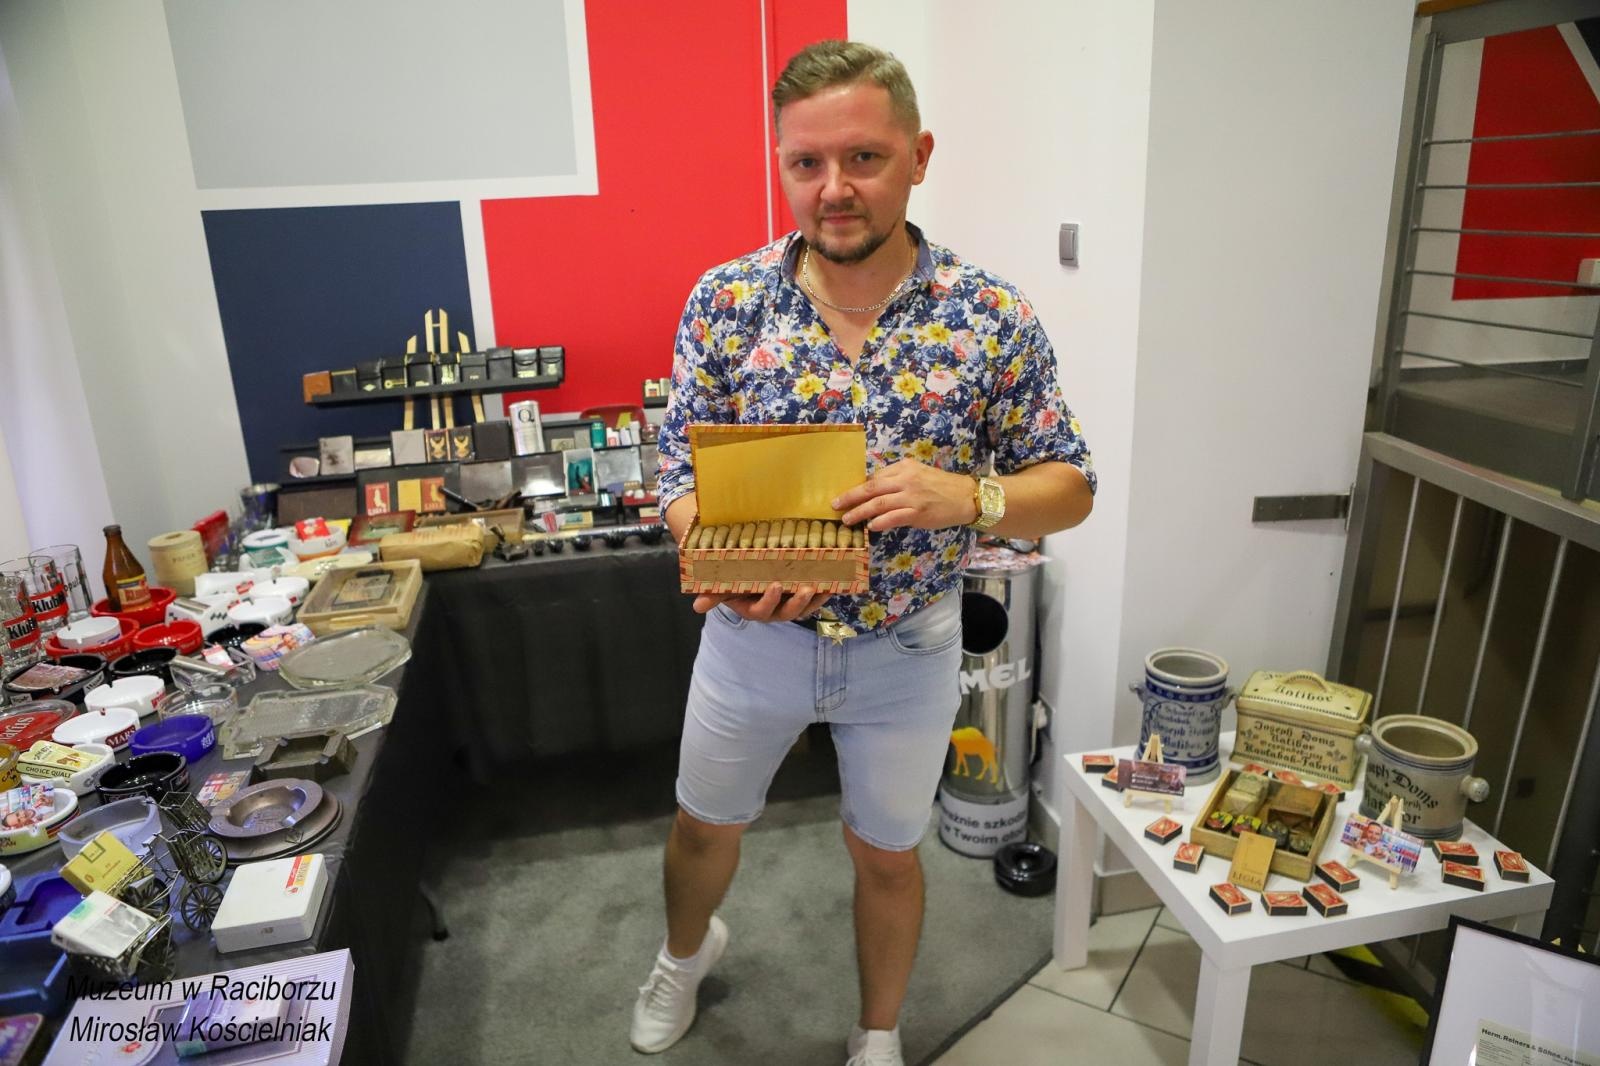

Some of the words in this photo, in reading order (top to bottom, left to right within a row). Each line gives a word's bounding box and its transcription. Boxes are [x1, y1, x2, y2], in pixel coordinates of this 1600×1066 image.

[107, 727, 136, 746] MARS
[25, 766, 50, 776] CHOICE
[1391, 769, 1439, 809] Doms
[953, 826, 999, 844] Twoim
